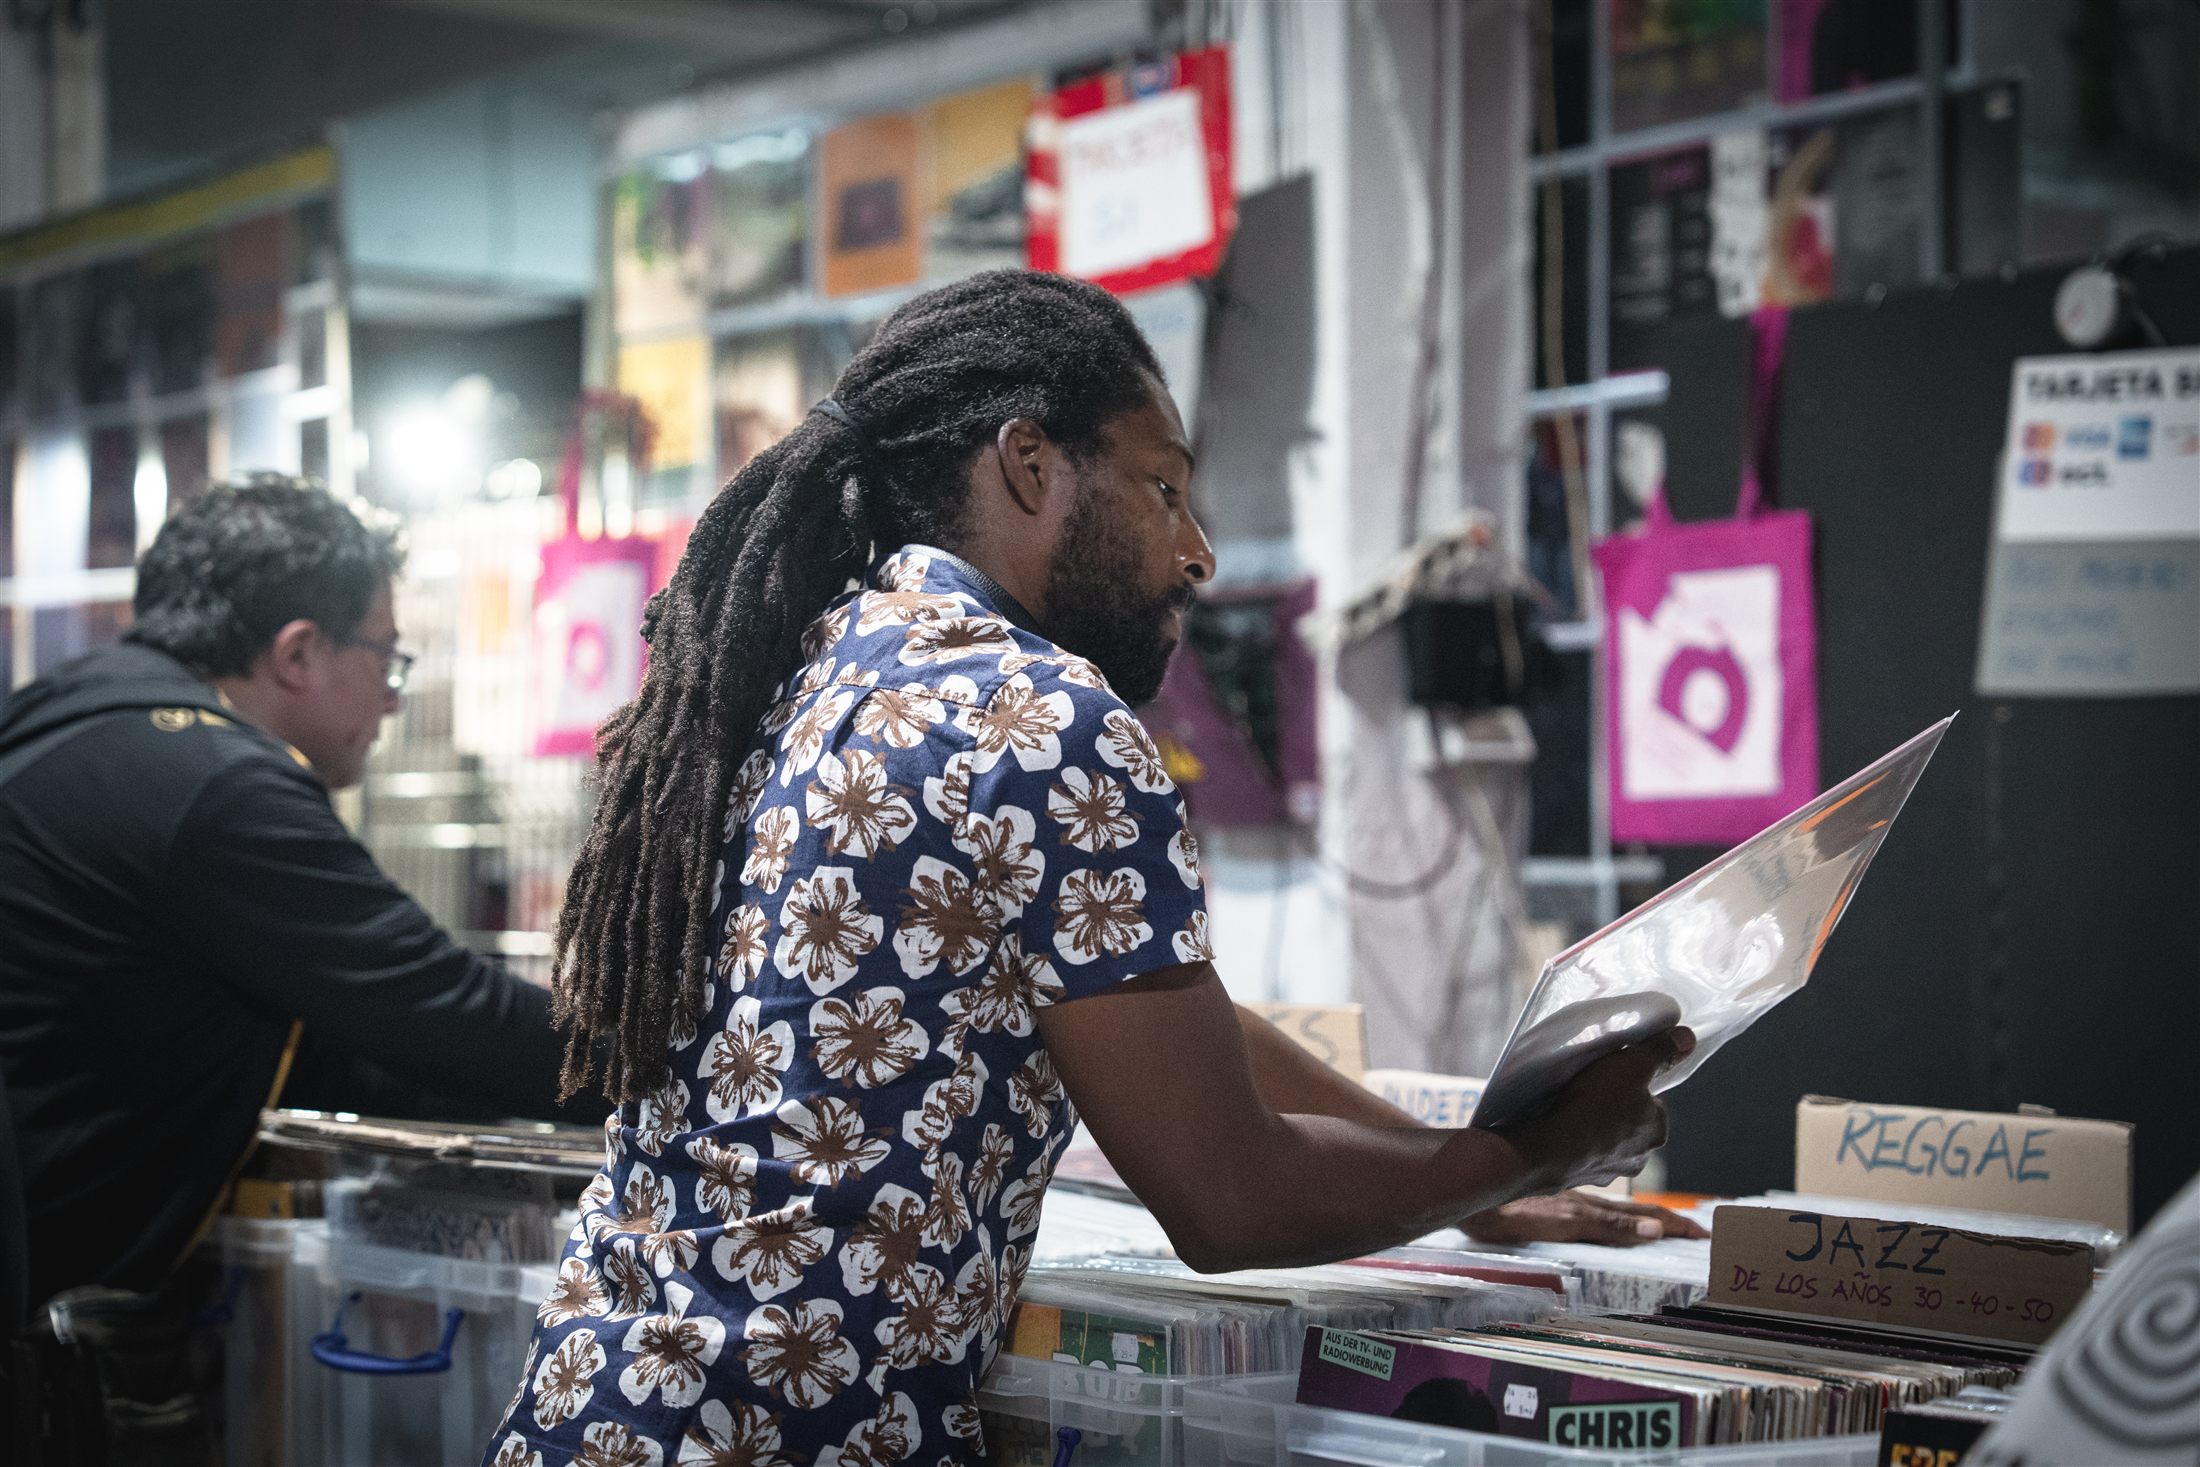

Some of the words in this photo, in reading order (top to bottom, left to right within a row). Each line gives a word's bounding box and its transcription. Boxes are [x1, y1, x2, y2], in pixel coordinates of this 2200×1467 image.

[1837, 1109, 2054, 1182] REGGAE
[1786, 1214, 1949, 1275] JAZZ
[1729, 1265, 1760, 1292] DE
[1776, 1272, 1818, 1299] LOS
[1832, 1271, 1892, 1307] AÑOS
[1323, 1345, 1389, 1375] RADIOWERBUNG
[1325, 1331, 1342, 1345] AUS
[1343, 1336, 1358, 1350] DER
[1360, 1341, 1371, 1353] TV-
[1373, 1346, 1392, 1361] UND
[1555, 1409, 1672, 1449] CHRIS
